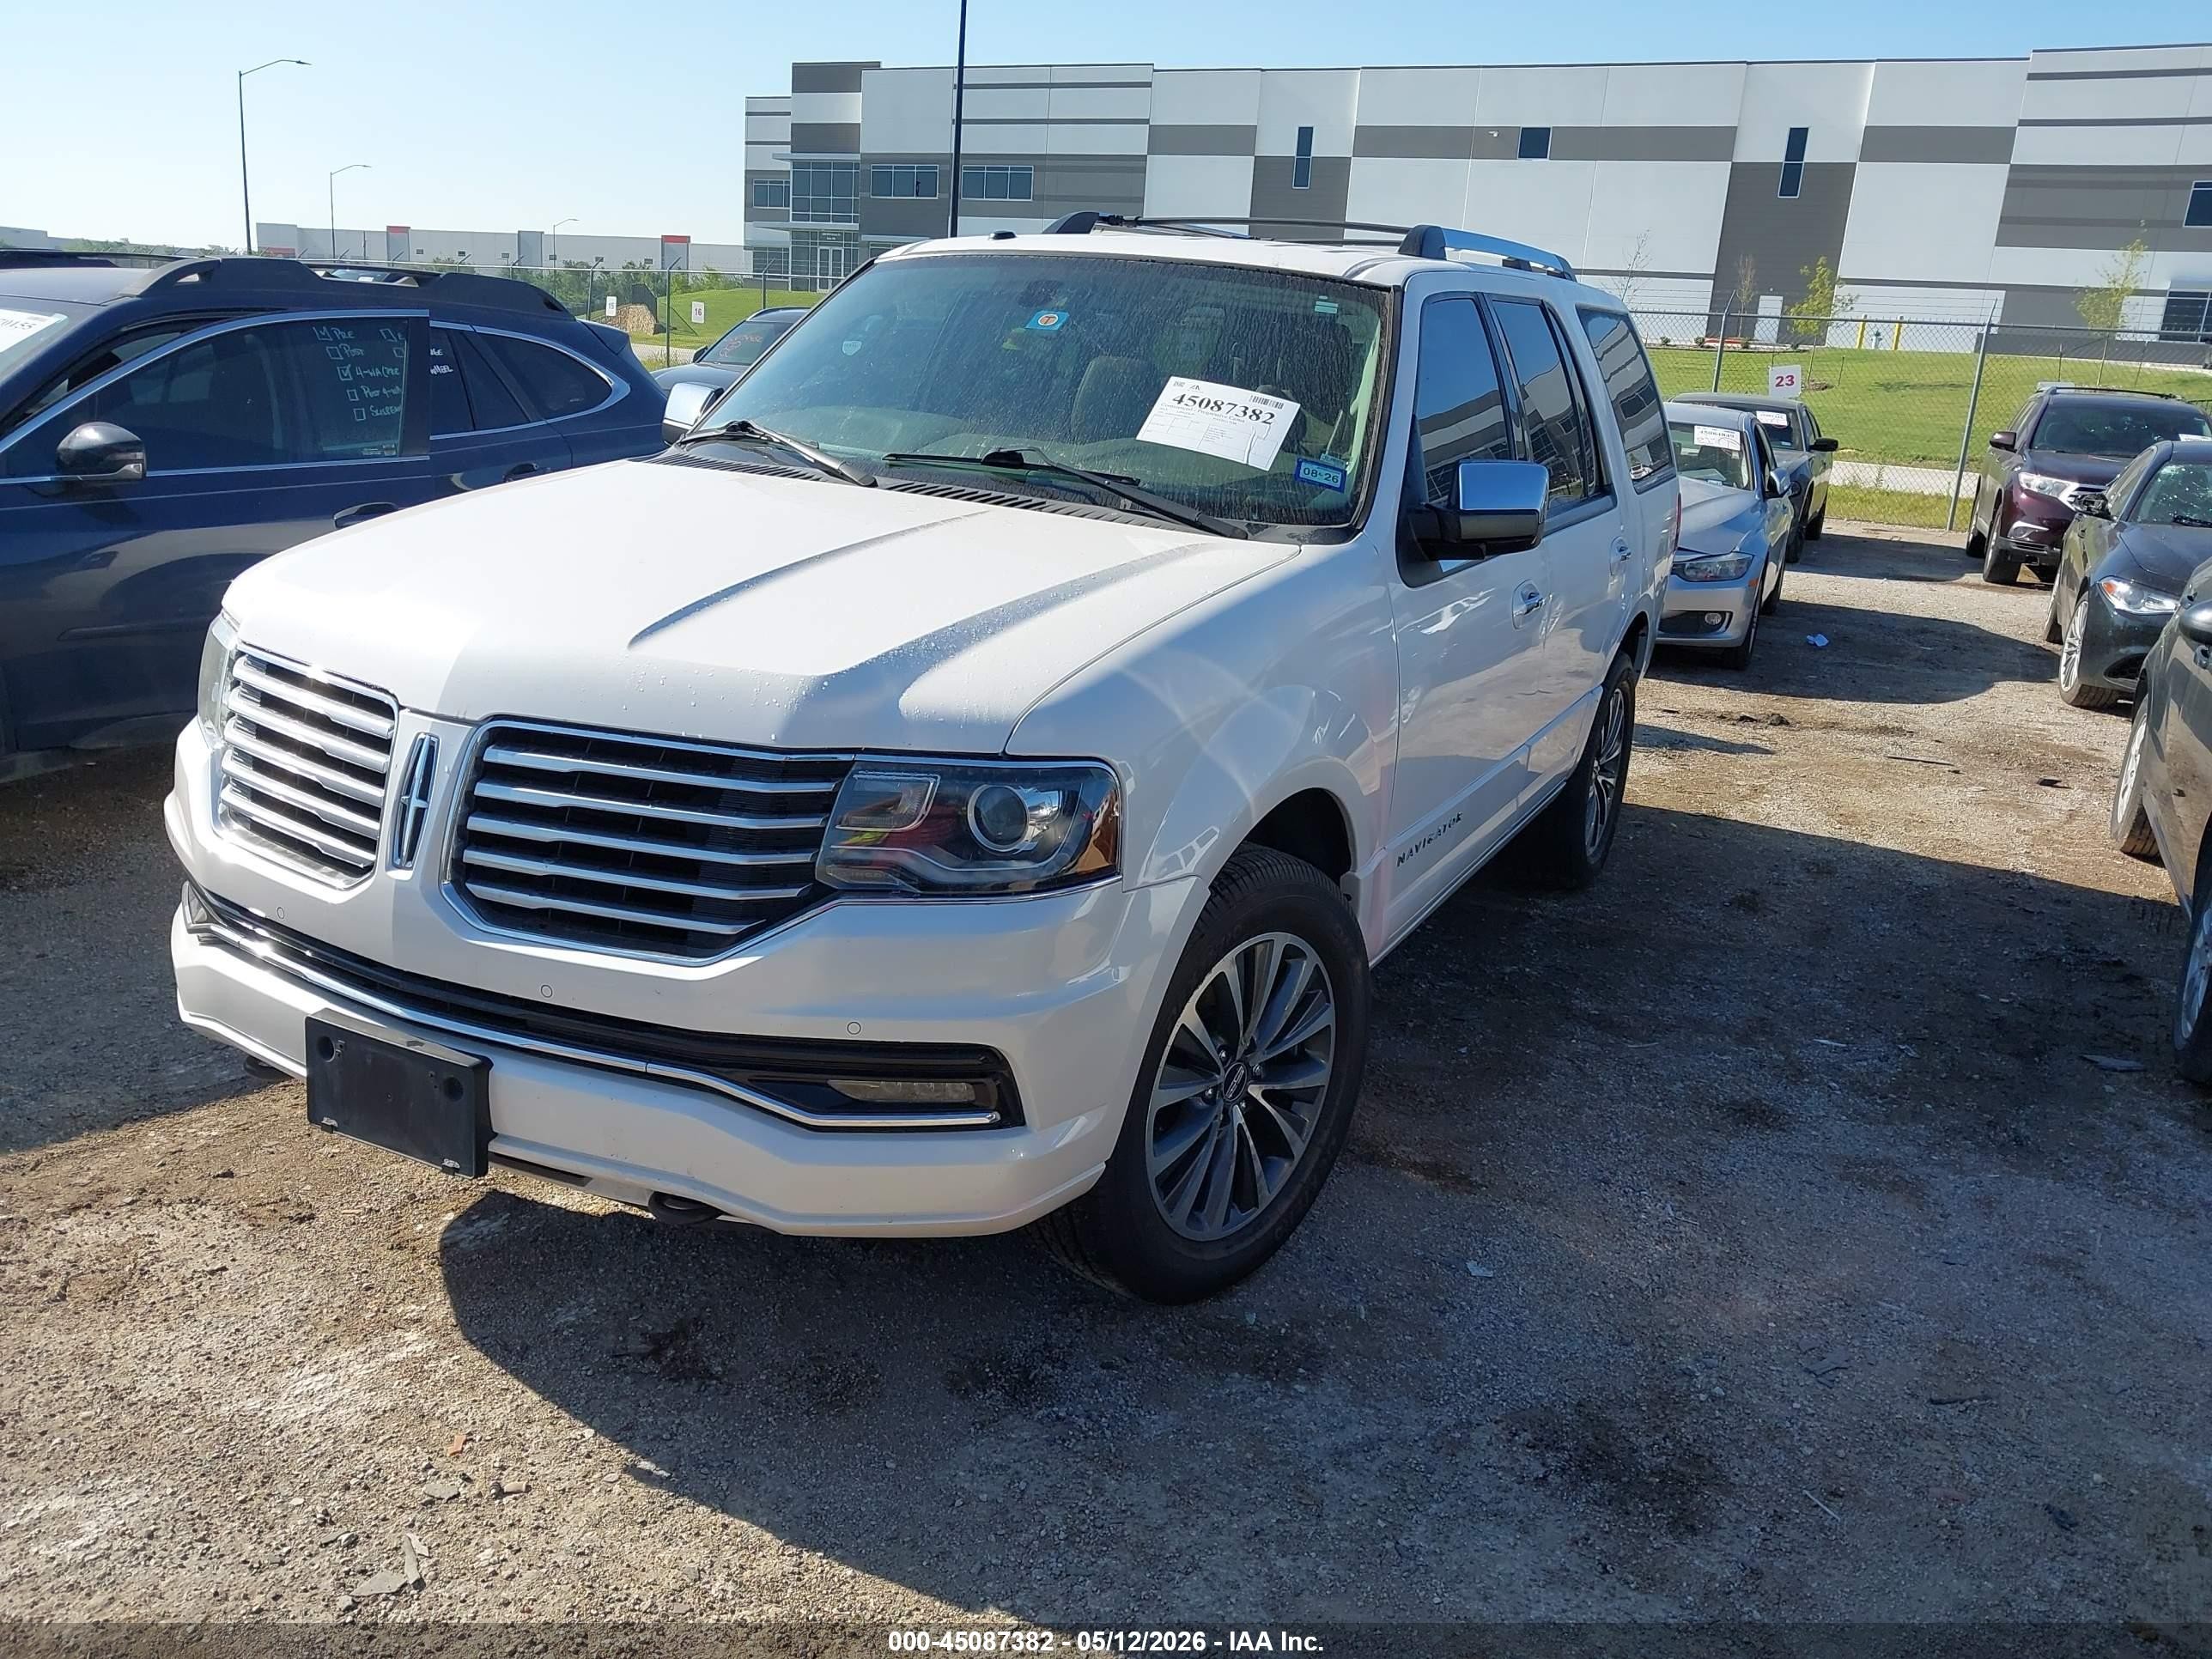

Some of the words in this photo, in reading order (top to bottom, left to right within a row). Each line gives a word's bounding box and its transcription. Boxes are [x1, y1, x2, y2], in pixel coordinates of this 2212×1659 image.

[695, 307, 702, 316] 16
[1775, 374, 1796, 388] 23
[1172, 392, 1276, 426] 45087382
[1303, 467, 1318, 477] 08
[1323, 473, 1340, 483] 26
[1396, 812, 1462, 866] NAVIGATOR
